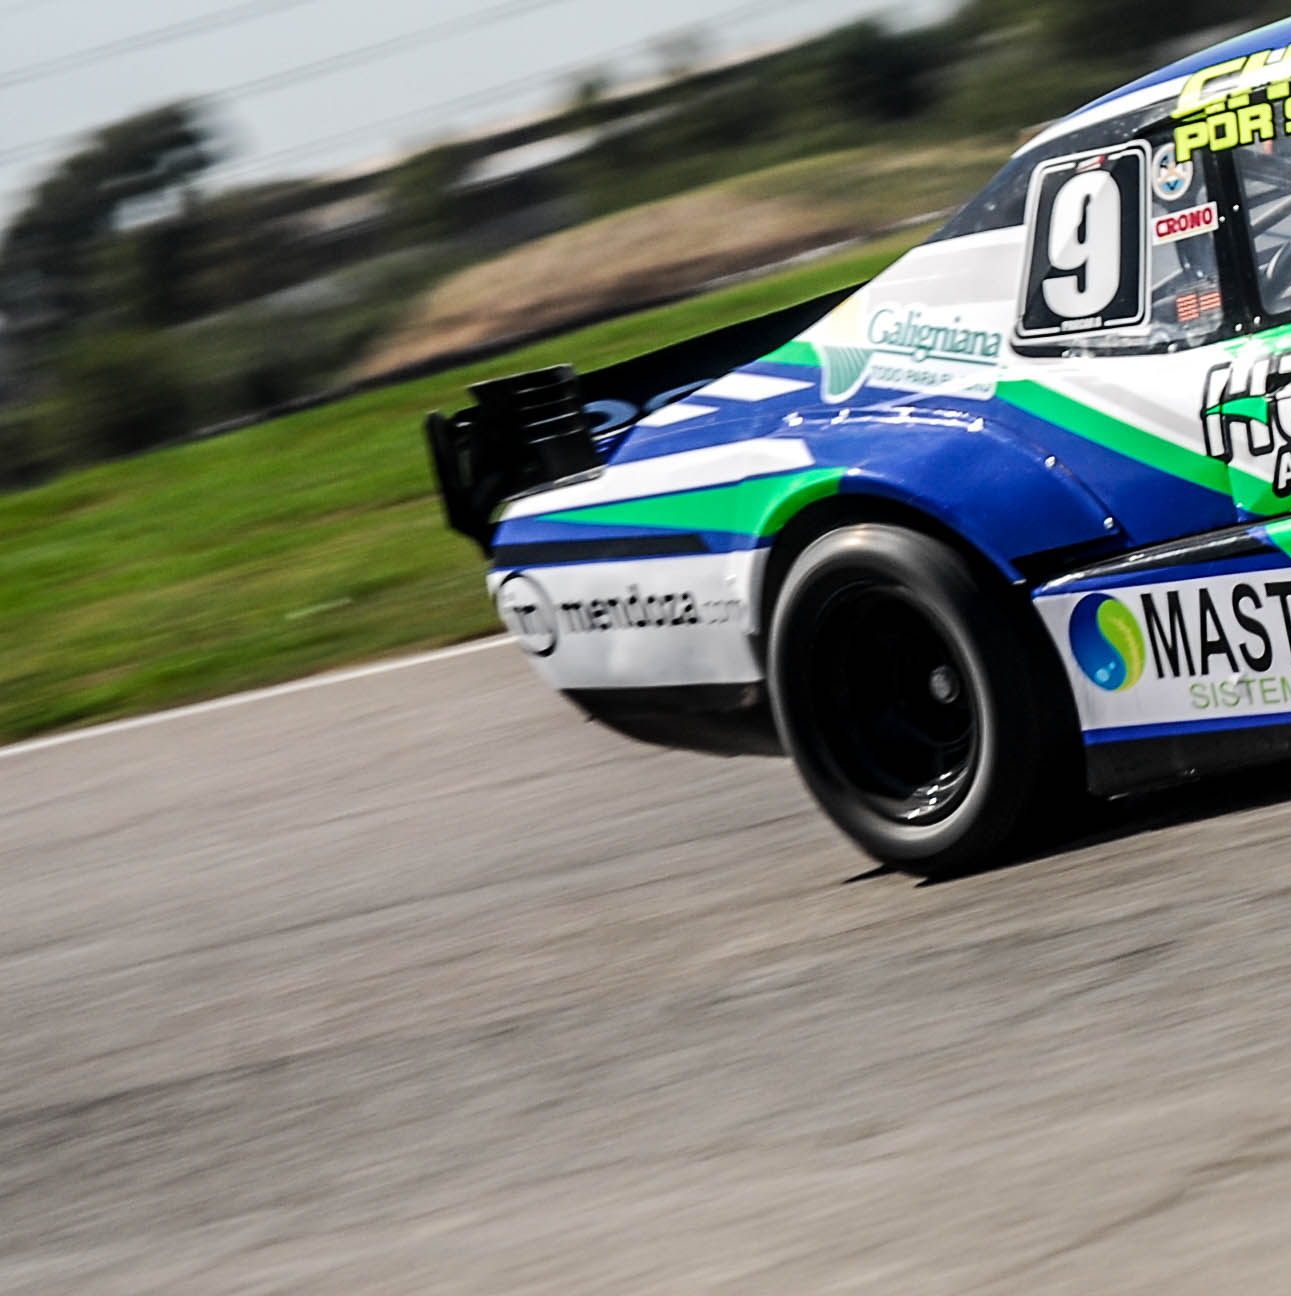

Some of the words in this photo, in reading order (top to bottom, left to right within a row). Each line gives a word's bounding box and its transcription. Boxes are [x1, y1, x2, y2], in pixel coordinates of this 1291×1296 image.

[1174, 102, 1275, 164] POR
[1041, 169, 1121, 319] 9
[1155, 206, 1214, 239] CRONO
[867, 307, 1003, 364] Galigniana
